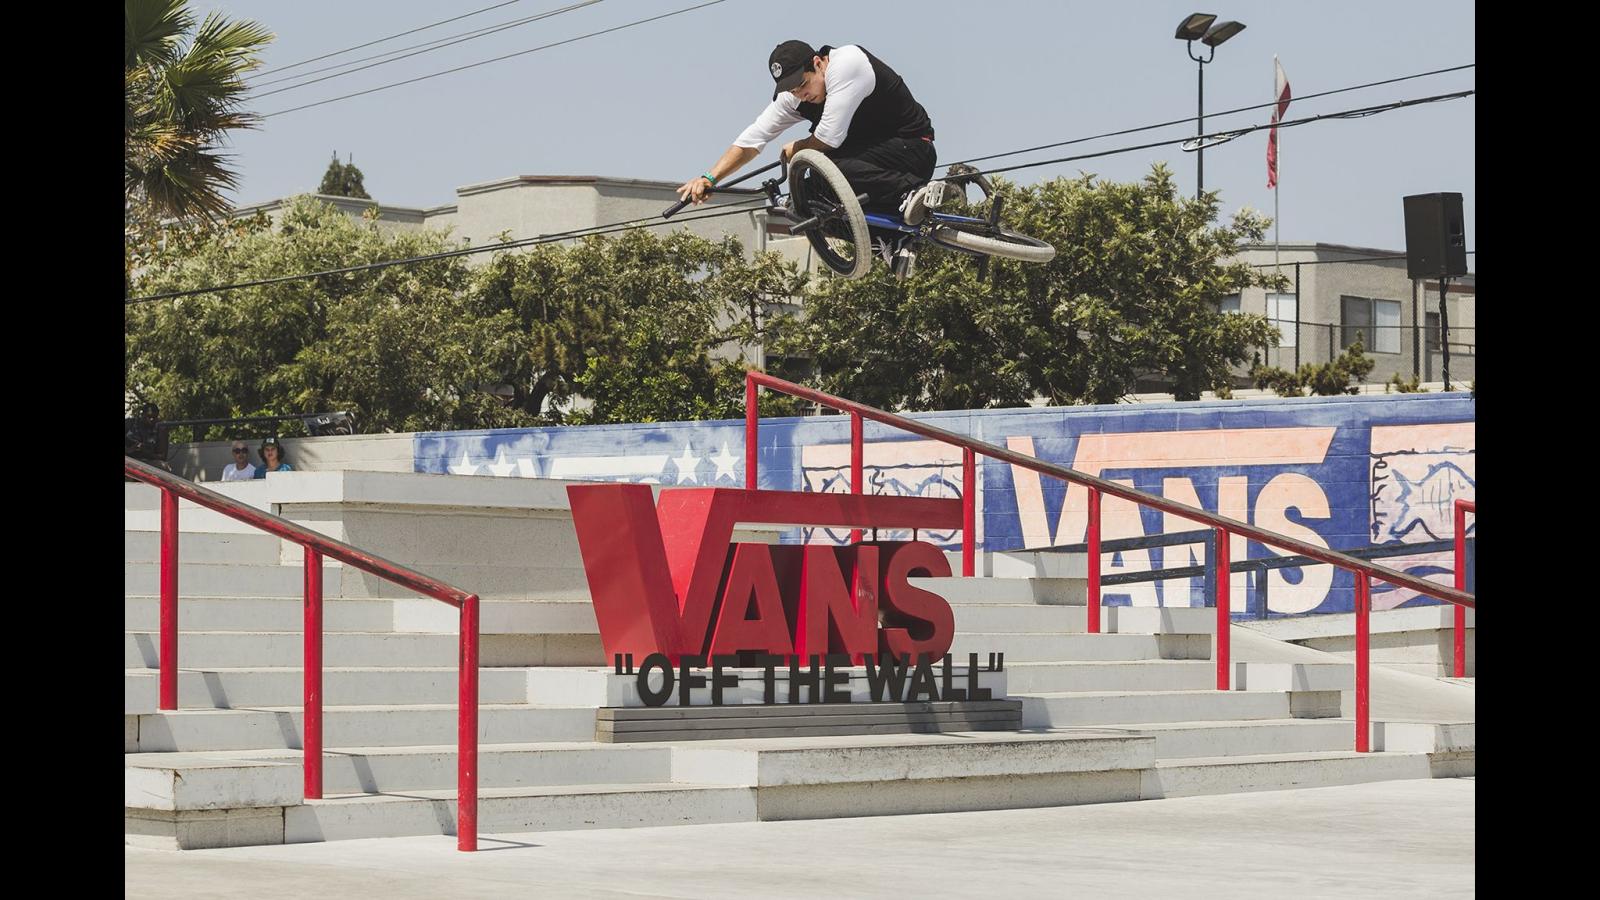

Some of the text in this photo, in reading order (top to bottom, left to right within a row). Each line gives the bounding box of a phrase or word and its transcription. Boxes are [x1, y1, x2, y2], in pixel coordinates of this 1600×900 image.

[566, 484, 963, 668] VANS
[1007, 427, 1337, 614] VANS
[757, 653, 852, 704] THE
